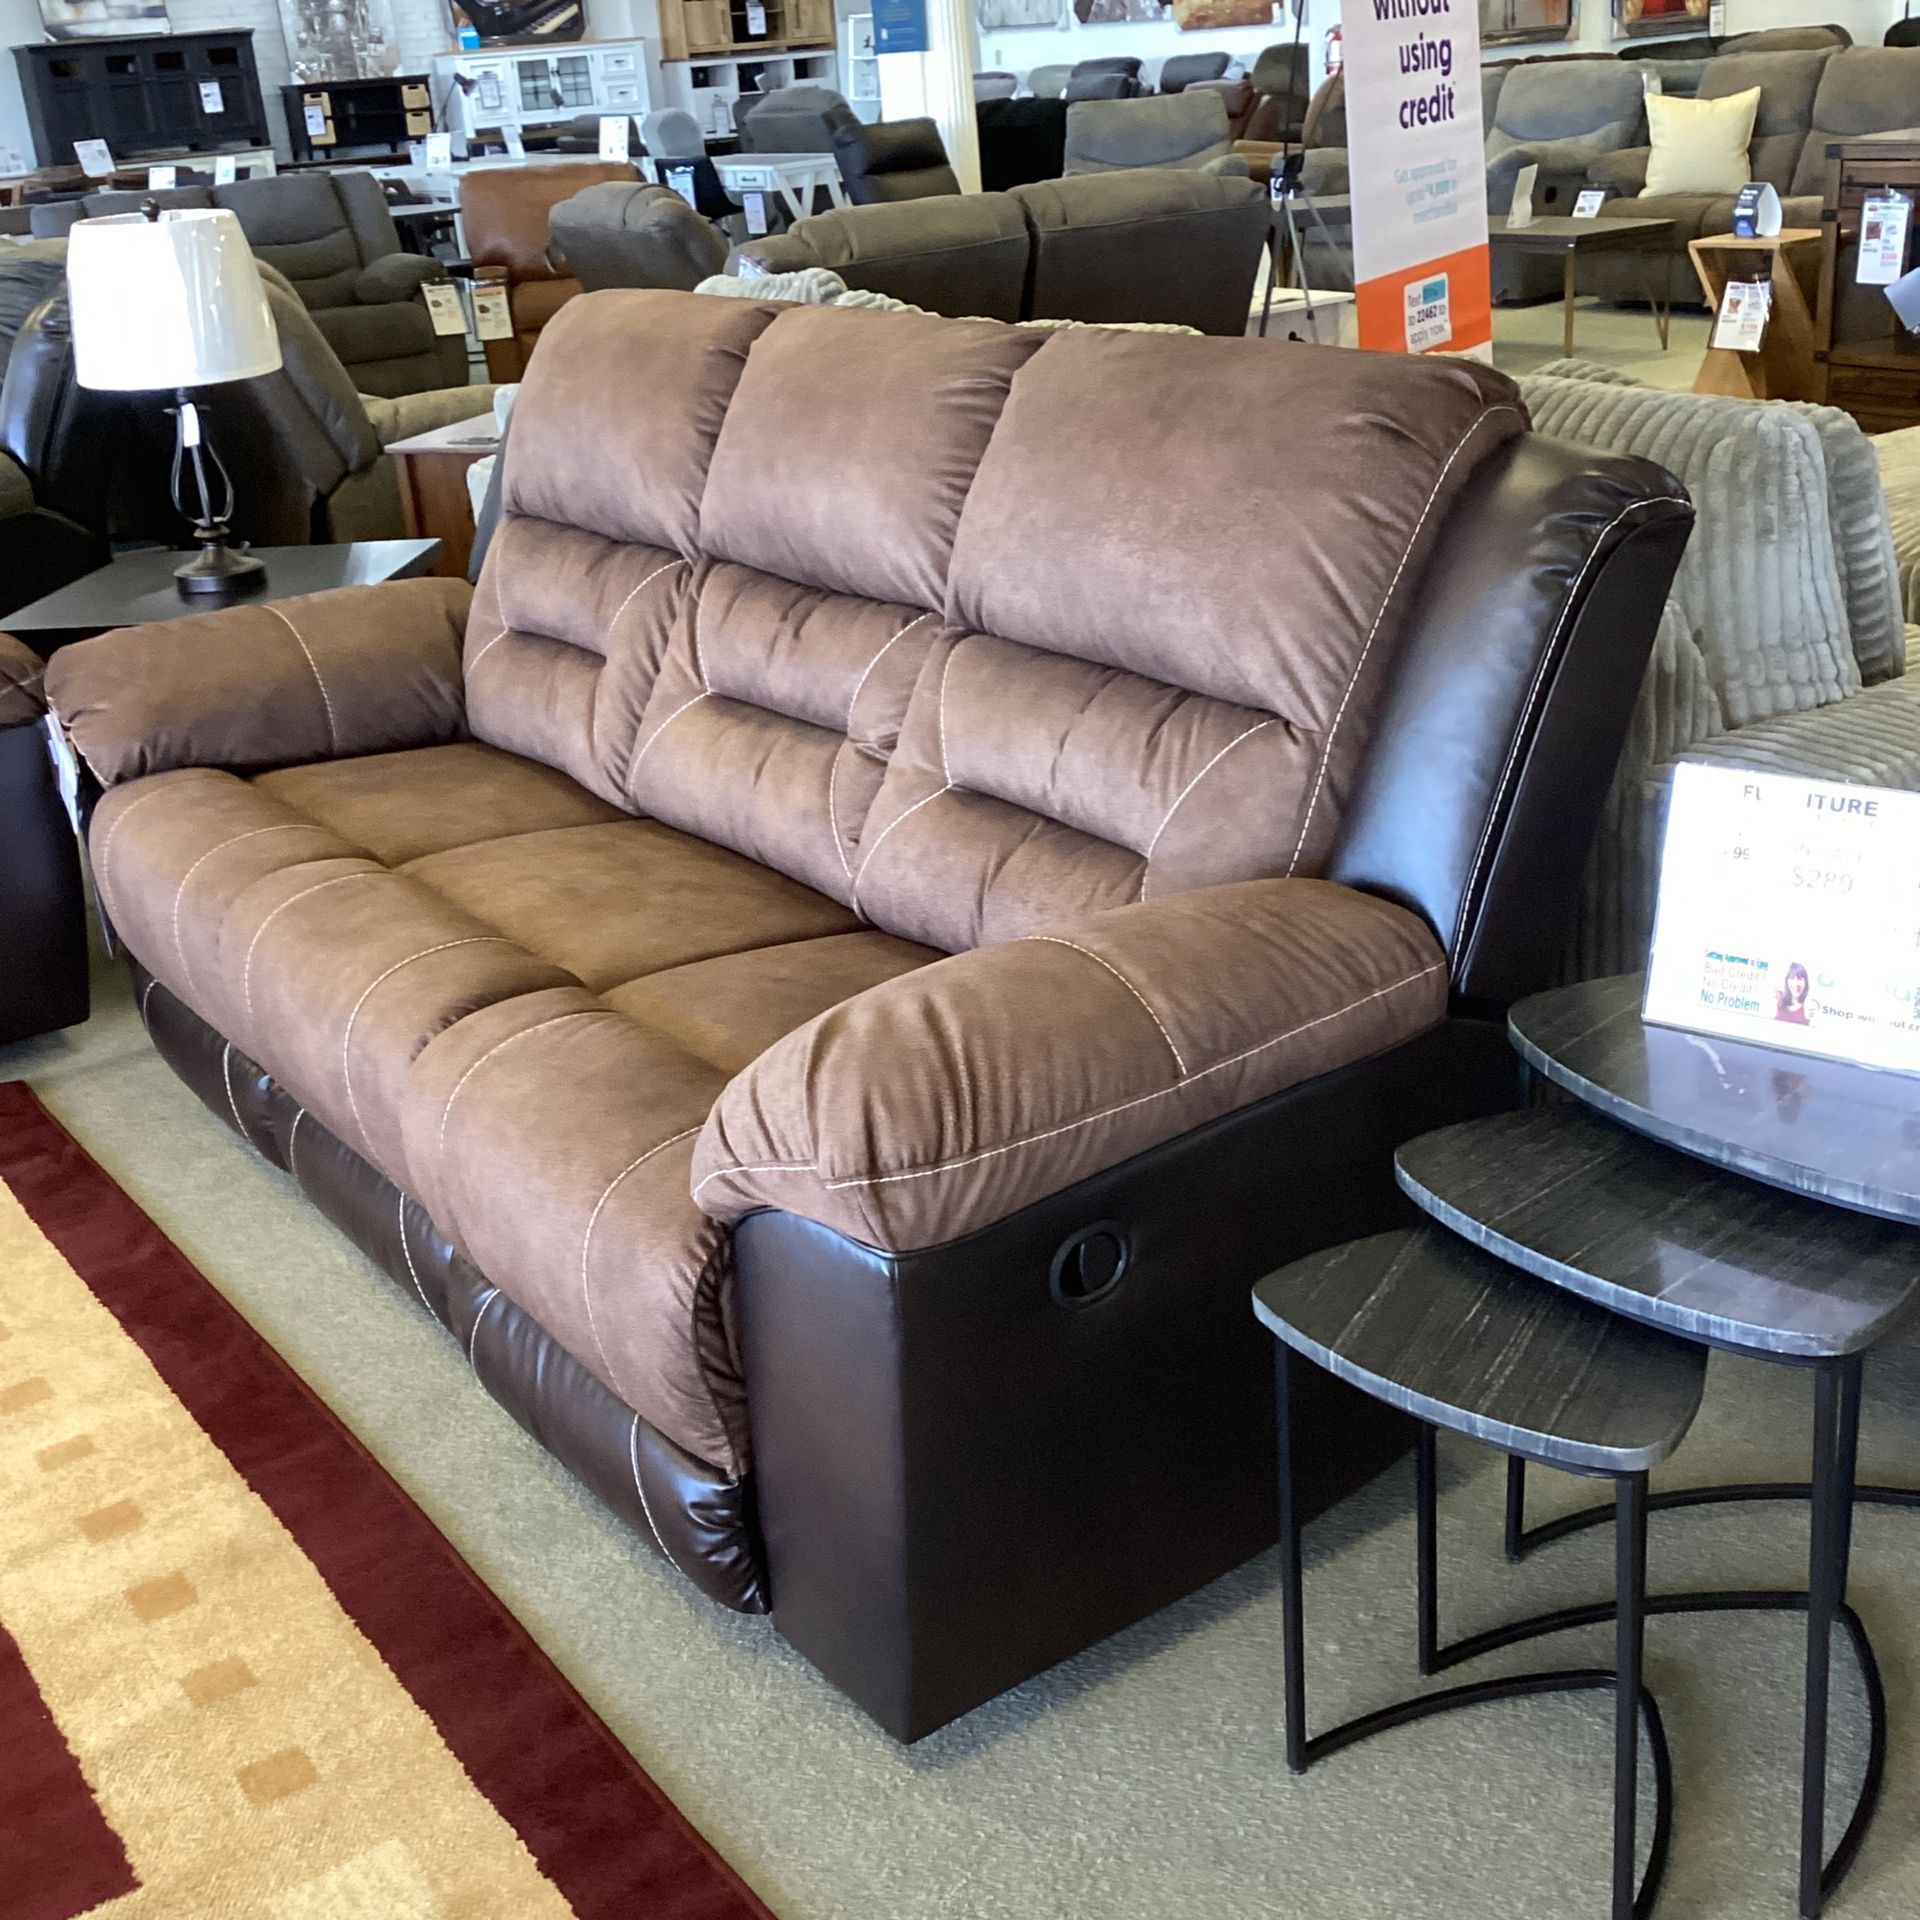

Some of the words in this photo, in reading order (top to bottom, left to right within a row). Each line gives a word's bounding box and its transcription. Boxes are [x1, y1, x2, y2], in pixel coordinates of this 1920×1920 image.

[1399, 31, 1452, 77] using
[1399, 82, 1455, 129] credit
[1743, 784, 1879, 817] FITURE
[1700, 988, 1715, 1004] No
[1717, 991, 1760, 1012] Problem
[1821, 1004, 1854, 1020] Shop
